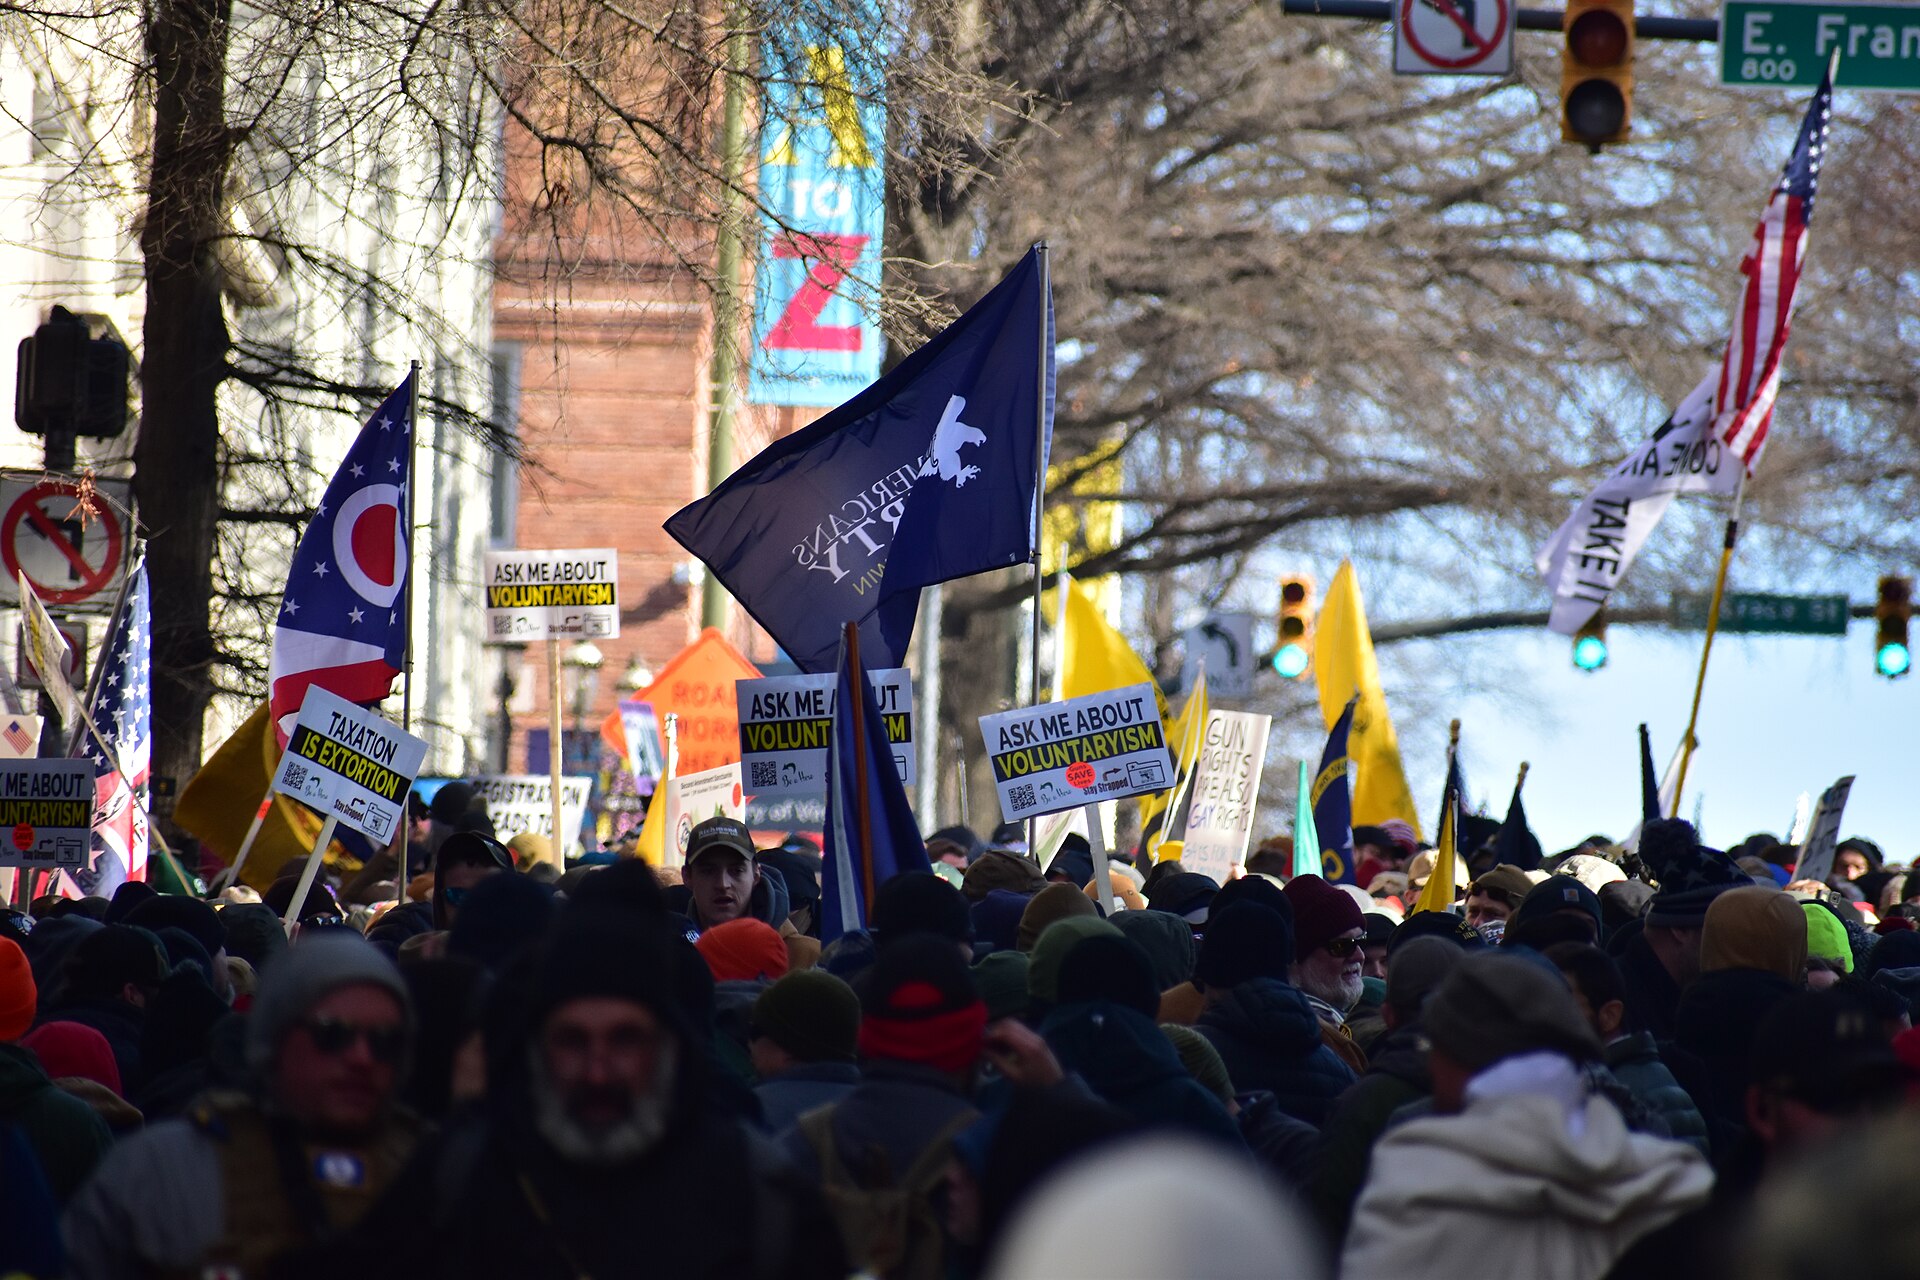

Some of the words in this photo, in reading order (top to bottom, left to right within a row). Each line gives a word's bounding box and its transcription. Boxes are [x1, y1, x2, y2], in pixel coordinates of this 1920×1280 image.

[1742, 12, 1787, 55] E.
[1741, 58, 1796, 81] 800
[789, 179, 852, 217] TO
[762, 233, 871, 352] Z
[1580, 497, 1632, 574] TAKE
[495, 563, 523, 583] ASK
[528, 563, 550, 582] ME
[553, 561, 607, 581] ABOUT
[489, 583, 612, 608] VOLUNTARYISM
[672, 681, 738, 708] ROA
[751, 691, 791, 720] ASK
[795, 689, 825, 716] ME
[327, 711, 399, 766] TAXATION
[746, 715, 906, 751] VOLUNTM
[999, 719, 1040, 750] ASK
[1040, 713, 1073, 740] ME
[1077, 697, 1144, 734] ABOUT
[1206, 718, 1249, 750] GUN
[300, 731, 321, 759] IS
[317, 740, 401, 800] EXTORTION
[997, 723, 1158, 779] VOLUNTARYISM
[6, 772, 28, 797] ME
[30, 772, 86, 797] ABOUT
[1067, 768, 1093, 782] SAVE
[1083, 786, 1098, 796] Stay
[1098, 777, 1129, 793] Strapped
[333, 798, 345, 814] Stay
[343, 804, 365, 822] Strapped
[492, 811, 530, 833] EADS
[1186, 803, 1216, 830] GAY
